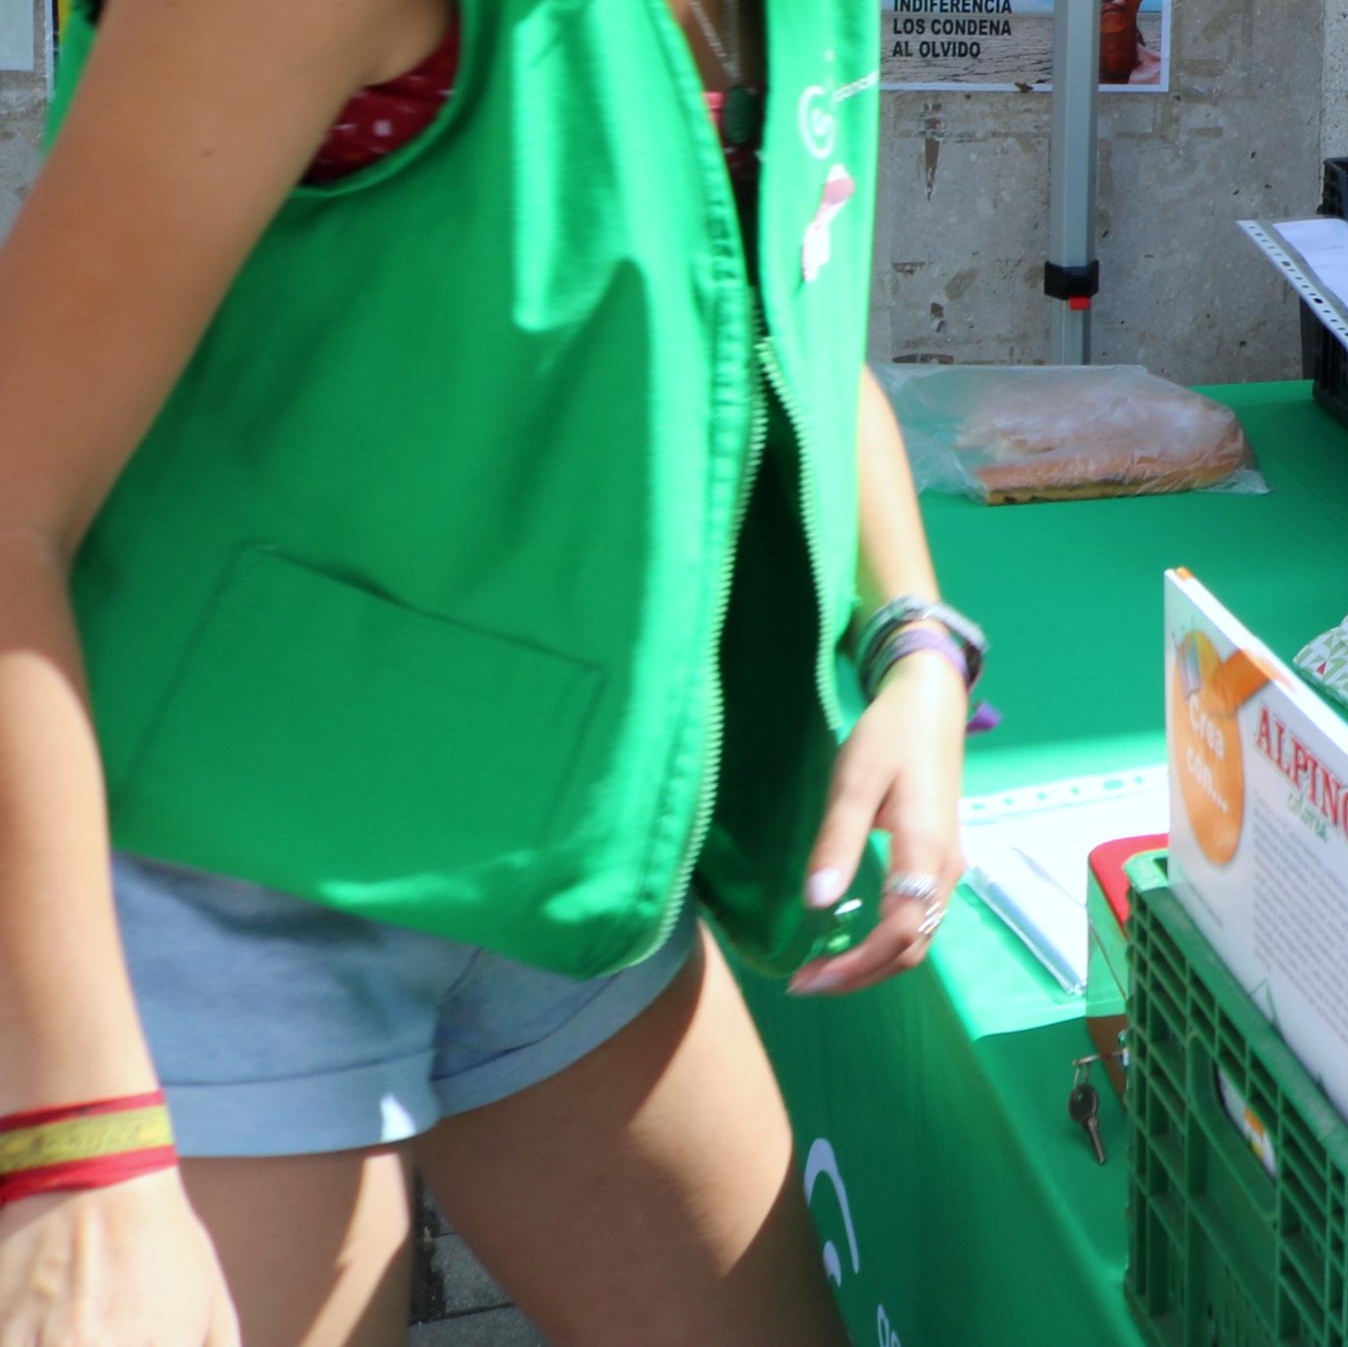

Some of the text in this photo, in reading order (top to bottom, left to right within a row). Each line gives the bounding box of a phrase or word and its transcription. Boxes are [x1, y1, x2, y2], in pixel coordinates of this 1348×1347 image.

[893, 18, 1012, 36] LOS CONDENA
[892, 40, 981, 58] AL OLVIDO
[1187, 692, 1226, 763] Crea
